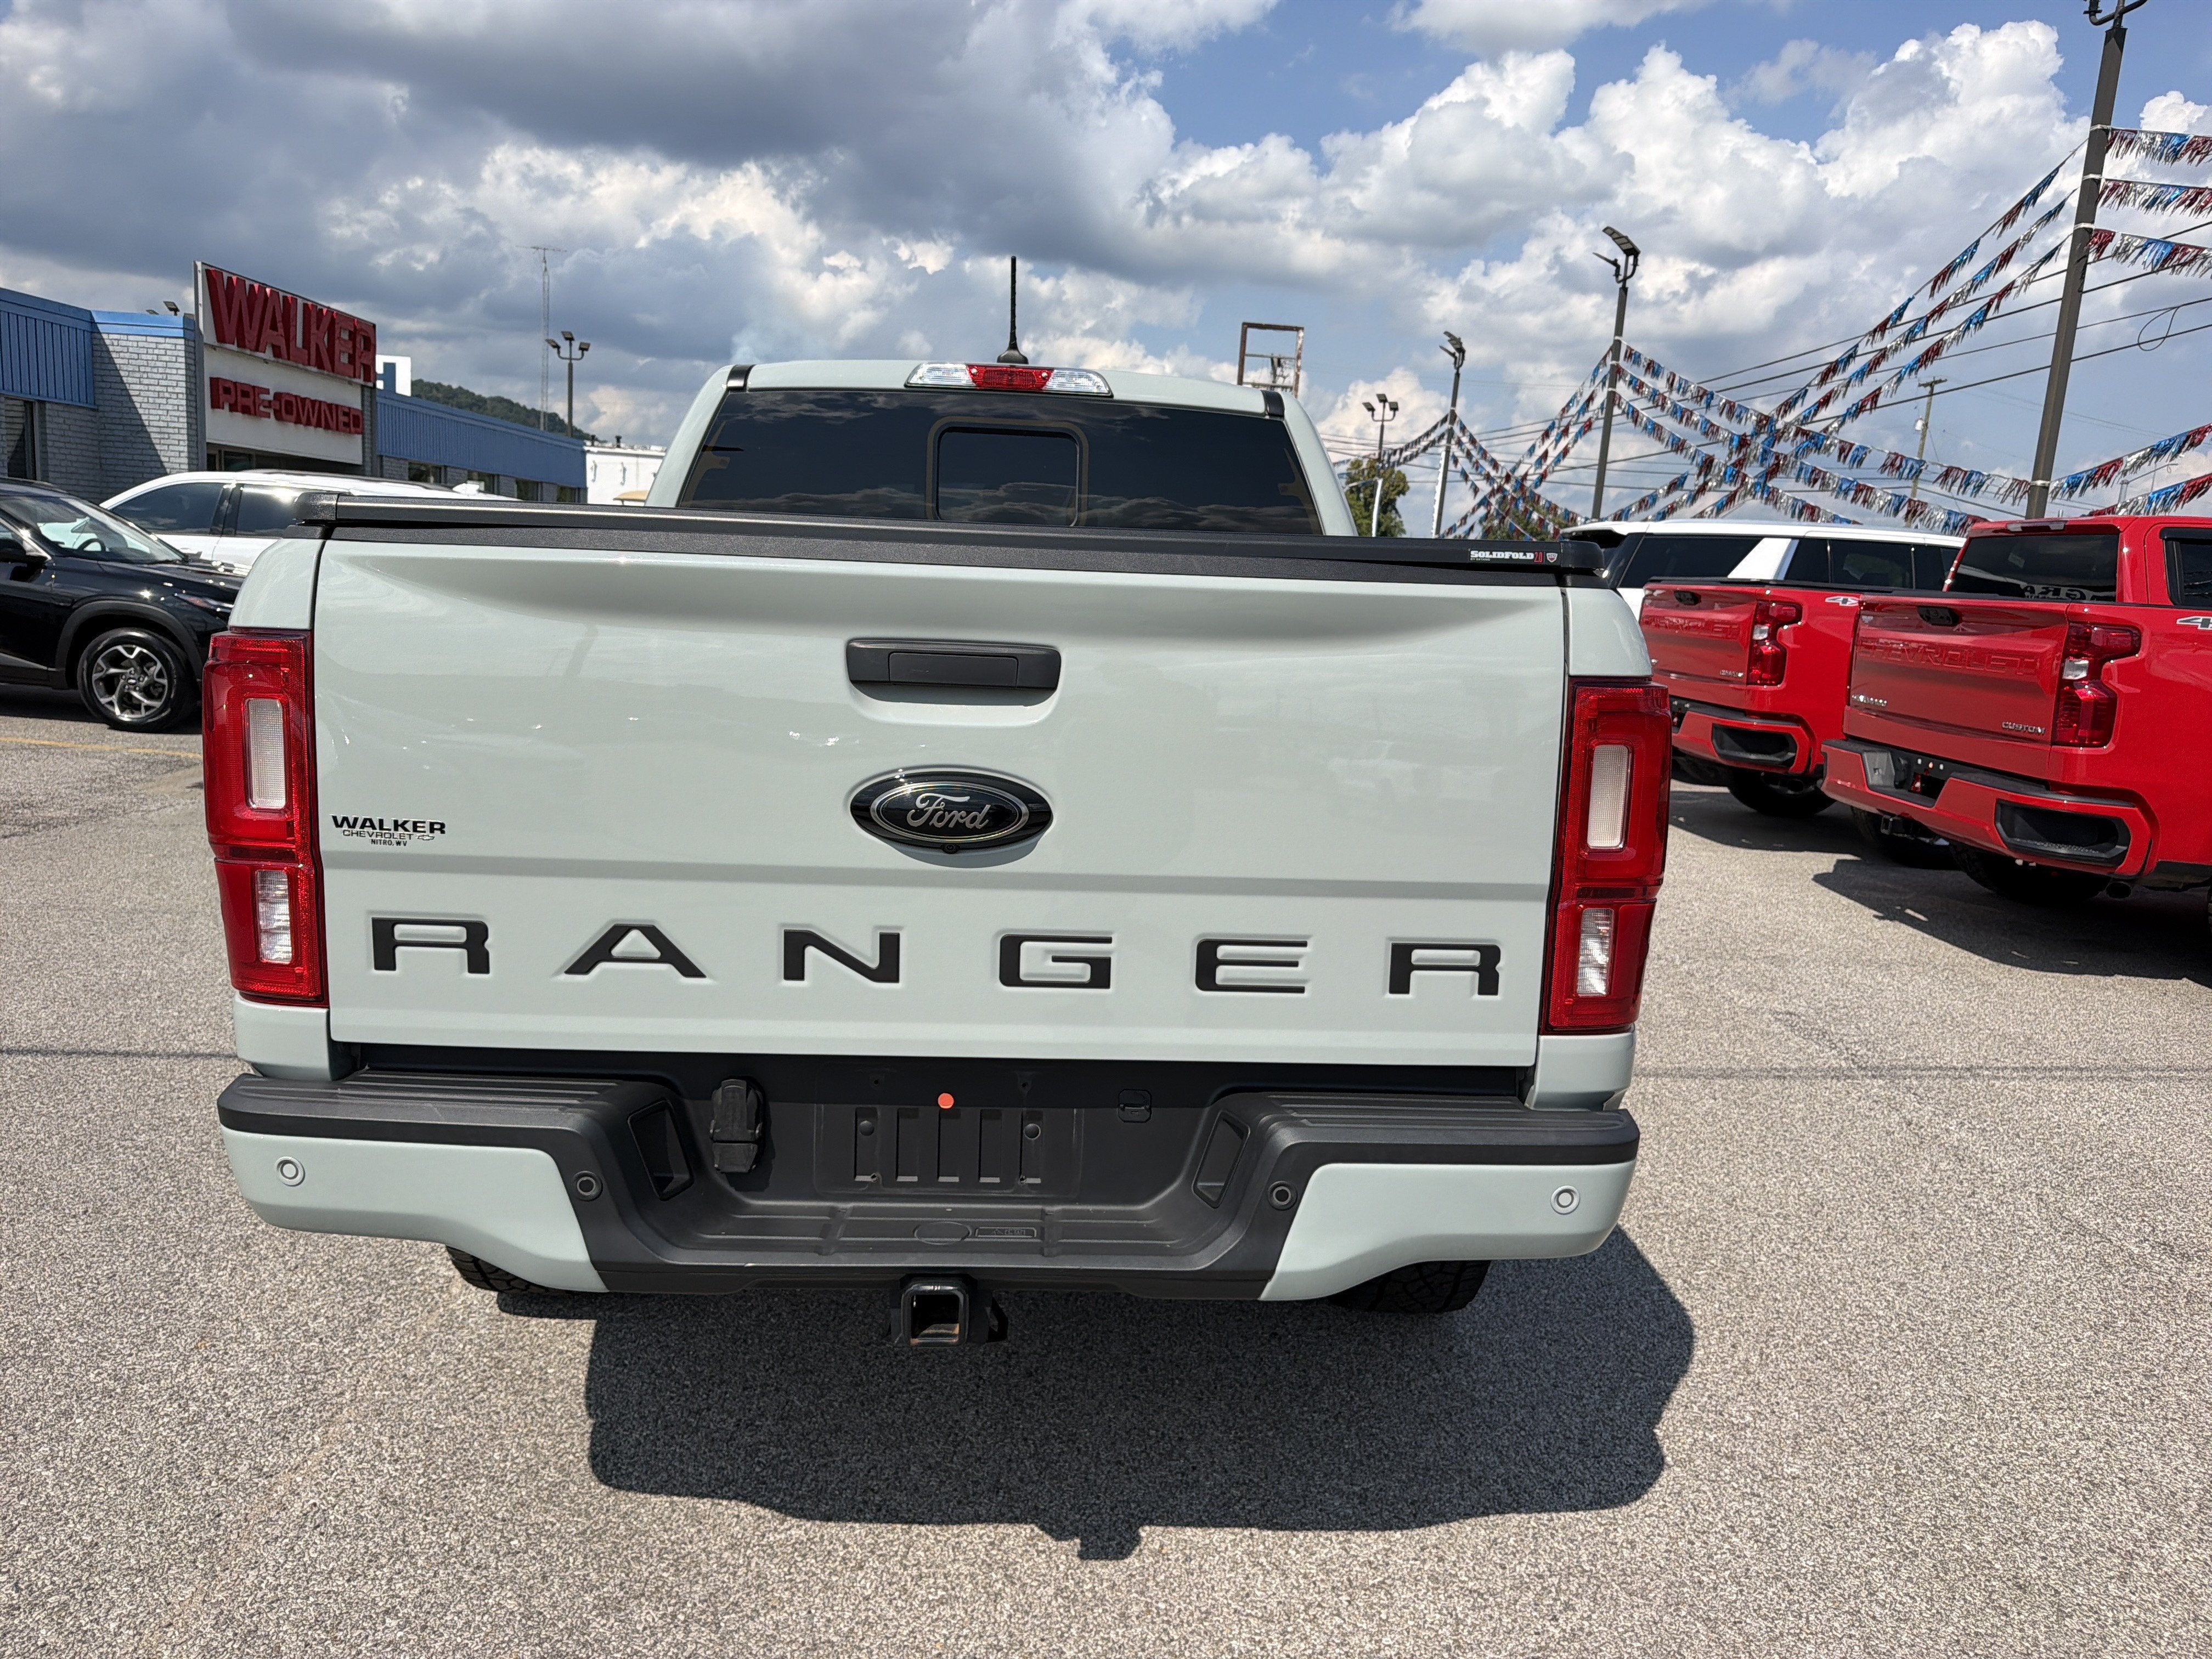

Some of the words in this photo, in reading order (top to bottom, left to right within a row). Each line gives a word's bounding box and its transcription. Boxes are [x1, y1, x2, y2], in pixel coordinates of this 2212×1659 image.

[205, 269, 376, 383] WALKER
[209, 376, 364, 435] PRE-OWNED
[1470, 550, 1534, 560] SOLIDFOLD
[331, 815, 446, 834] WALKER
[906, 793, 991, 830] Ford
[343, 829, 414, 840] CHEVROLET
[371, 917, 1501, 996] RANGER
